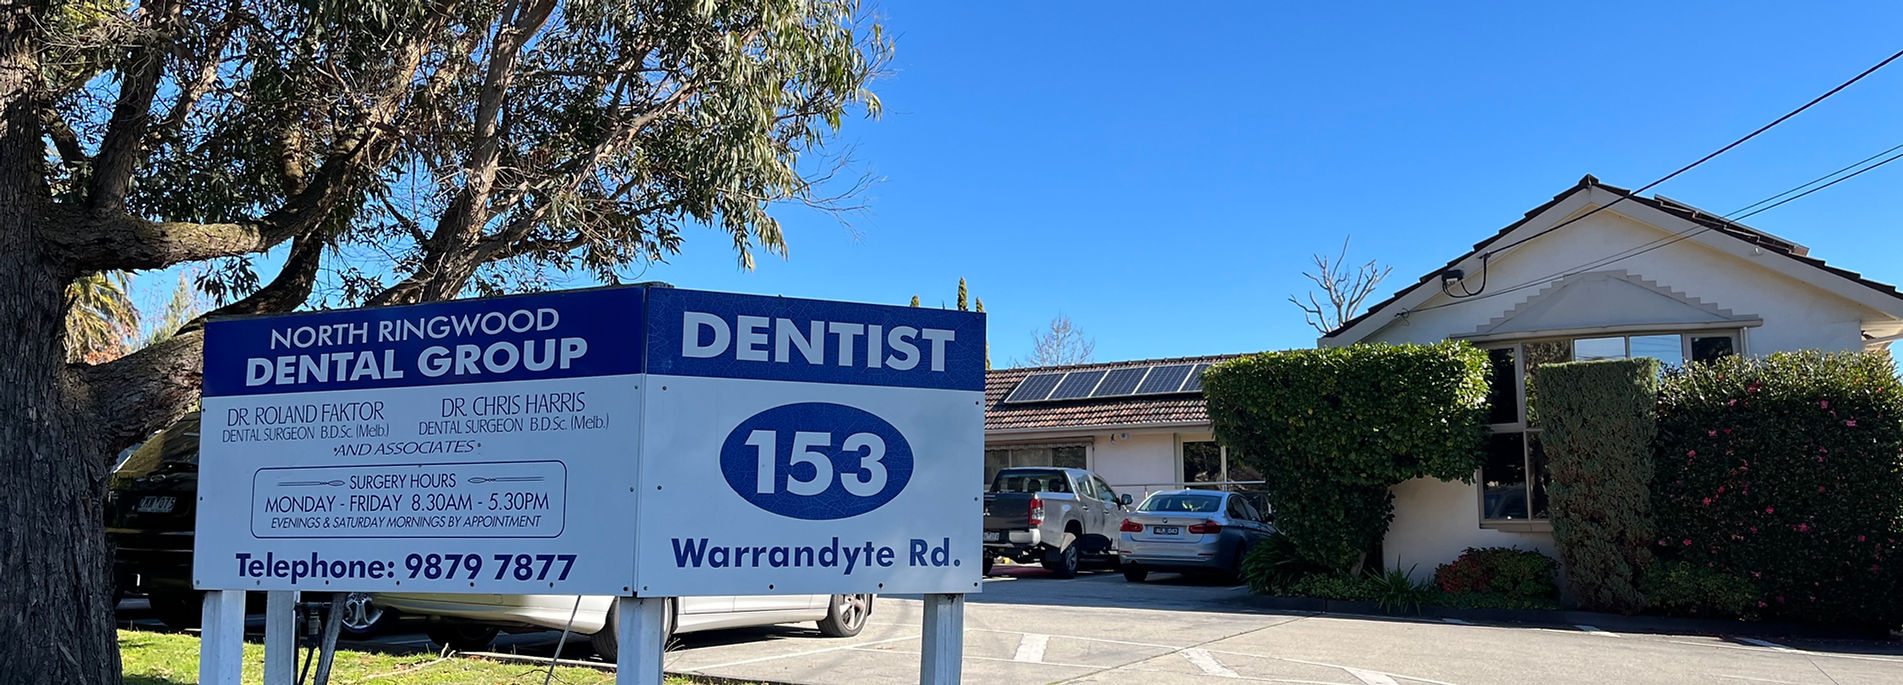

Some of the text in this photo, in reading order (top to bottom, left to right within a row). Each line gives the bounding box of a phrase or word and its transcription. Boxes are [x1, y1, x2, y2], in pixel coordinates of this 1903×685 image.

[270, 307, 560, 351] NORTH RINGWOOD
[682, 311, 956, 372] DENTIST
[245, 336, 588, 387] DENTAL GROUP
[255, 404, 318, 426] ROLAND
[321, 401, 384, 422] FAKTOR
[473, 395, 521, 416] CHRIS
[525, 391, 586, 414] HARRIS
[222, 429, 262, 443] DENTAL
[264, 426, 315, 441] SURGEON
[356, 423, 390, 439] (Melb.)
[418, 420, 462, 436] DENTAL
[465, 418, 523, 434] SURGEON
[570, 413, 610, 431] (Melb.)
[744, 429, 888, 497] 153
[349, 473, 456, 489] SURGERY HOURS
[265, 495, 336, 513] MONDAY
[349, 494, 403, 512] FRIDAY
[411, 493, 473, 511] 8.30AM
[488, 492, 549, 510] 5.30PM
[271, 515, 542, 529] EVENINGS & SATURDAY MORNINGS BY APPOINTMENT
[235, 552, 578, 584] Telephone: 9879 7877
[671, 536, 961, 576] Warrandyte Rd.
